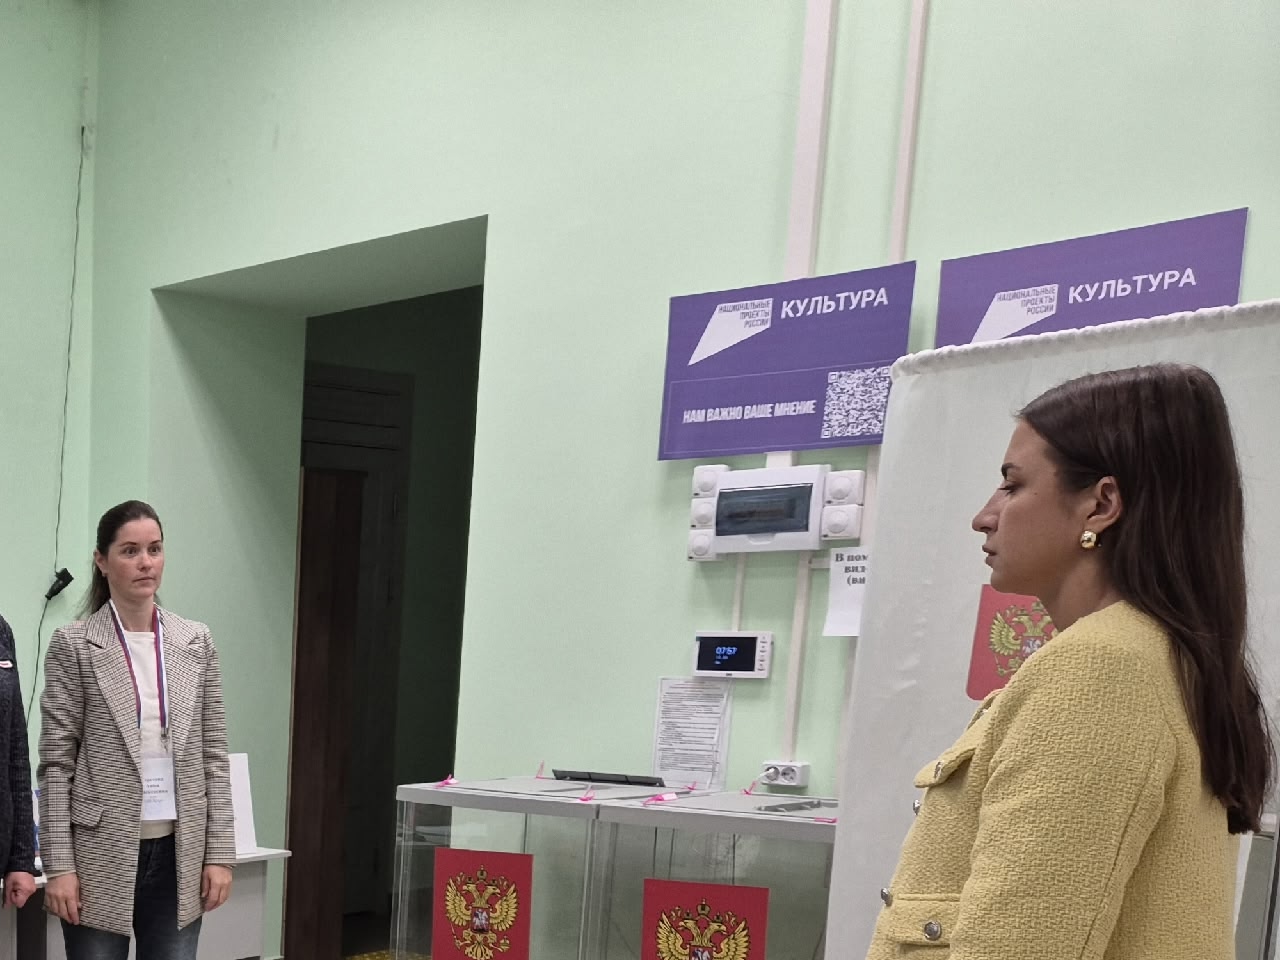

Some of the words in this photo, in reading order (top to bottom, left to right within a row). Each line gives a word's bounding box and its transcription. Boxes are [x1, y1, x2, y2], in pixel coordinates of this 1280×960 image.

[1068, 267, 1197, 304] КУЛЬТУРА
[780, 288, 889, 319] КУЛЬТУРА
[1026, 304, 1054, 316] РОССИИ
[682, 409, 706, 424] НАМ
[706, 405, 743, 421] ВАЖНО
[743, 403, 774, 419] ВАШЕ
[774, 400, 817, 417] МНЕНИЕ
[835, 553, 845, 562] В
